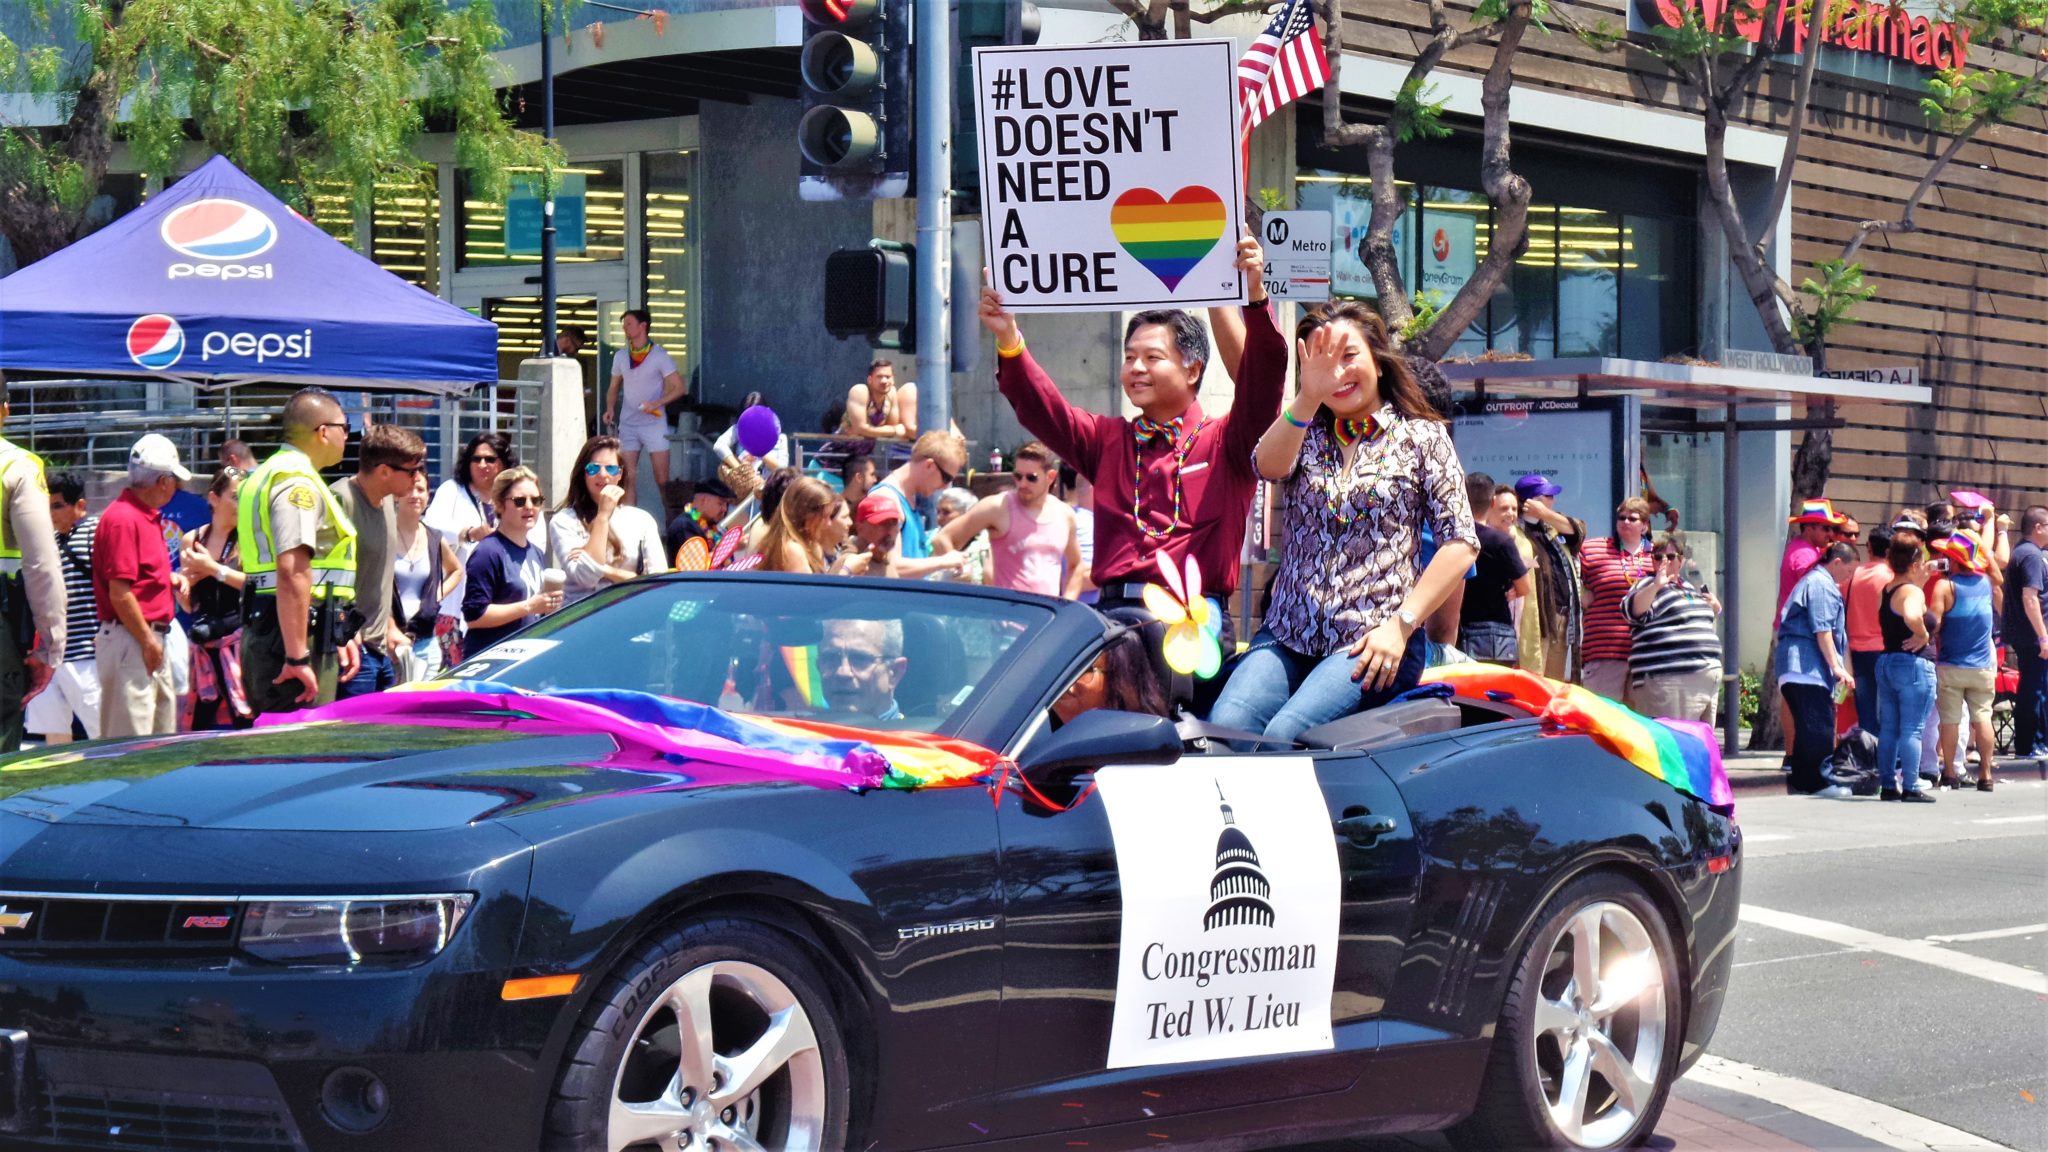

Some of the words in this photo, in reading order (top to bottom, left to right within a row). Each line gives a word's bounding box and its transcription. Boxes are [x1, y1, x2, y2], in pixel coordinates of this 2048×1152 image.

[991, 65, 1132, 110] #LOVE
[994, 108, 1179, 157] DOESN'T
[997, 160, 1111, 203] NEED
[1000, 208, 1029, 248] A
[1292, 239, 1327, 252] Metro
[168, 263, 273, 281] pepsi
[1003, 252, 1118, 294] CURE
[1422, 272, 1464, 286] oneyGram
[202, 329, 312, 363] pepsi
[1726, 350, 1753, 369] WEST
[1755, 352, 1813, 377] HOLLYWOOD
[1486, 402, 1534, 412] OUTFRONT
[1539, 401, 1579, 410] JCDecaux
[183, 915, 231, 928] RS
[898, 919, 995, 939] CAMARO
[1142, 942, 1316, 988] Congressman
[611, 951, 686, 1040] COOPE
[1147, 1000, 1194, 1040] Ted
[1204, 997, 1235, 1035] W.
[1244, 993, 1301, 1031] Lieu
